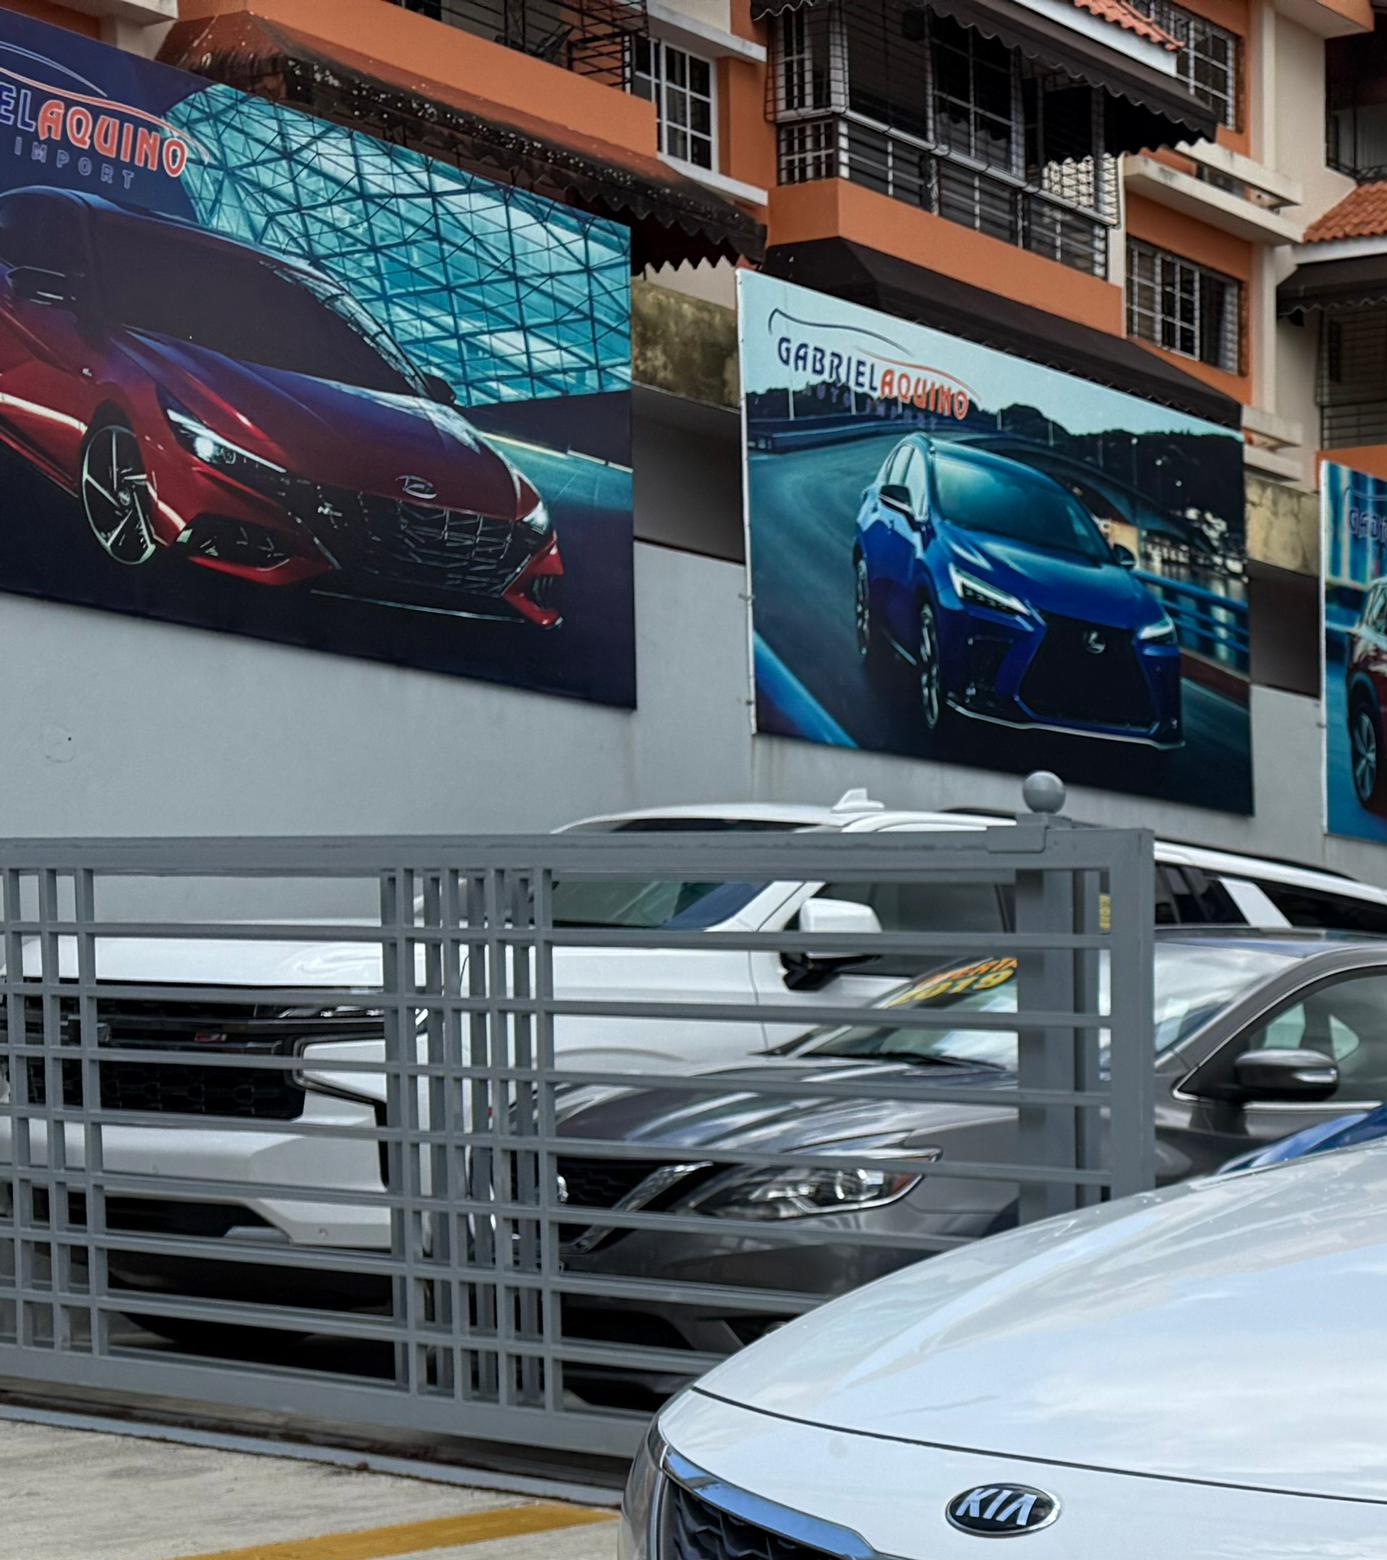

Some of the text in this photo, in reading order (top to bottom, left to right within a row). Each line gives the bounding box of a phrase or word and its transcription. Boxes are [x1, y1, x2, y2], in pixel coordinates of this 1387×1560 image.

[14, 136, 135, 190] IMPORT
[37, 99, 188, 178] AQUINO
[777, 336, 970, 421] GABRIEL AQUINO
[955, 1487, 1038, 1526] KIA
